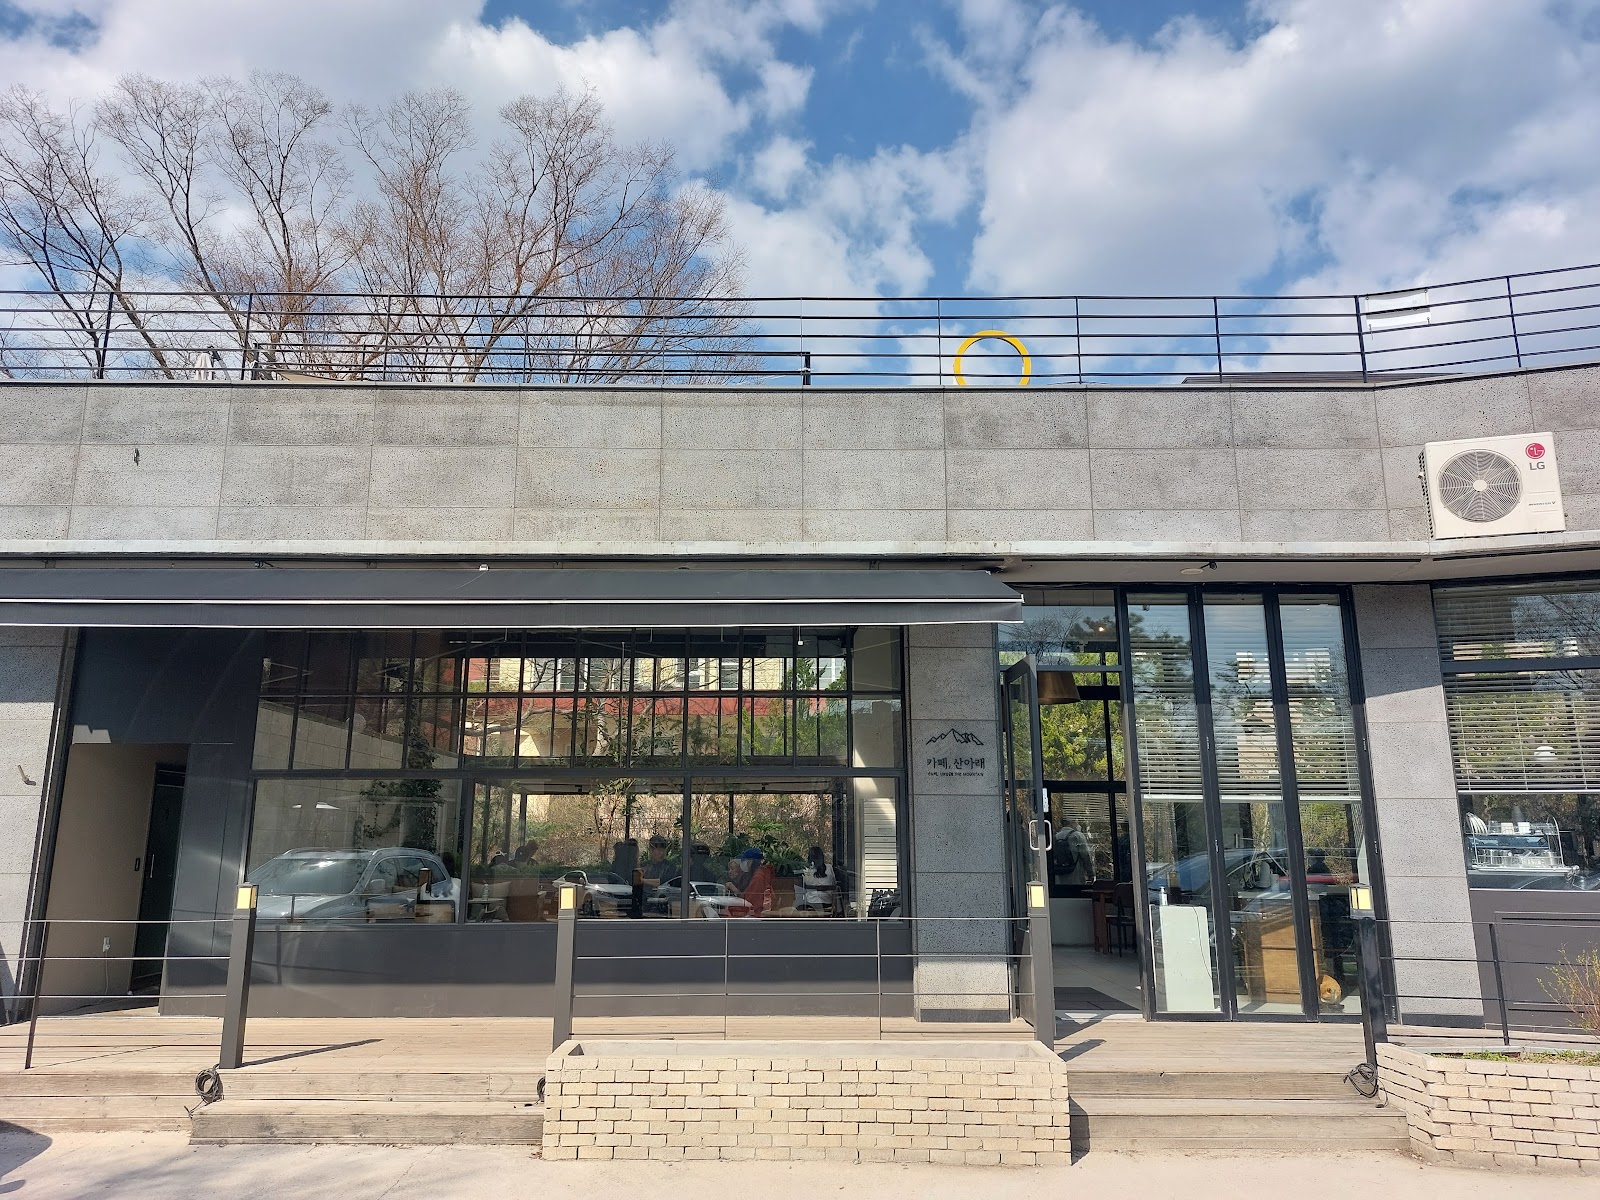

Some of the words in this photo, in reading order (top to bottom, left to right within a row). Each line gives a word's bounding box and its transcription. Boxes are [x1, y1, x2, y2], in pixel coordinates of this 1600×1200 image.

[1529, 461, 1546, 471] LG
[927, 757, 951, 769] 카페,
[953, 757, 986, 769] 산아래
